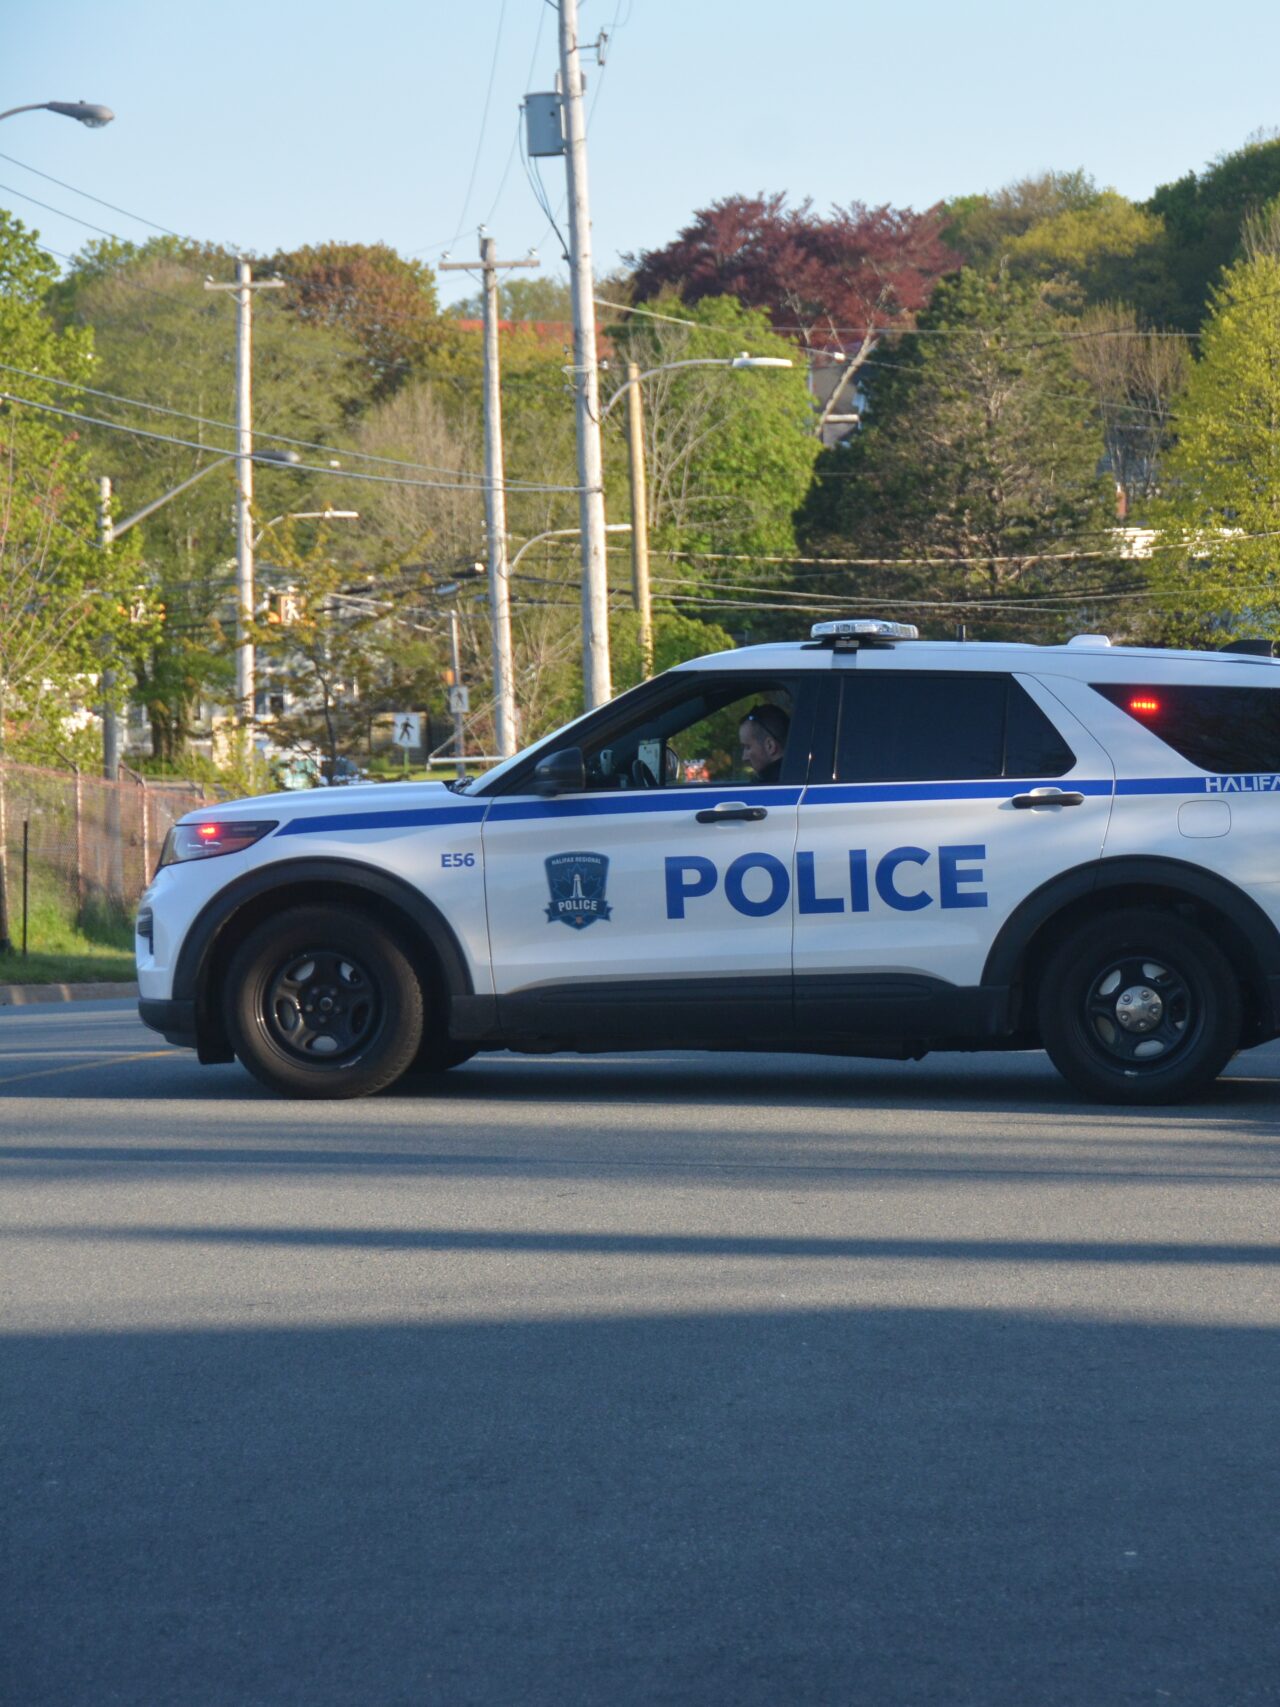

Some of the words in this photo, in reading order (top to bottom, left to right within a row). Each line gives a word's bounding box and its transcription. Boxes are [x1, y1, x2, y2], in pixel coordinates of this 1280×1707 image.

[441, 852, 476, 868] E56
[552, 857, 574, 865] HALIFAX
[664, 844, 990, 920] POLICE
[558, 900, 598, 911] POLICE
